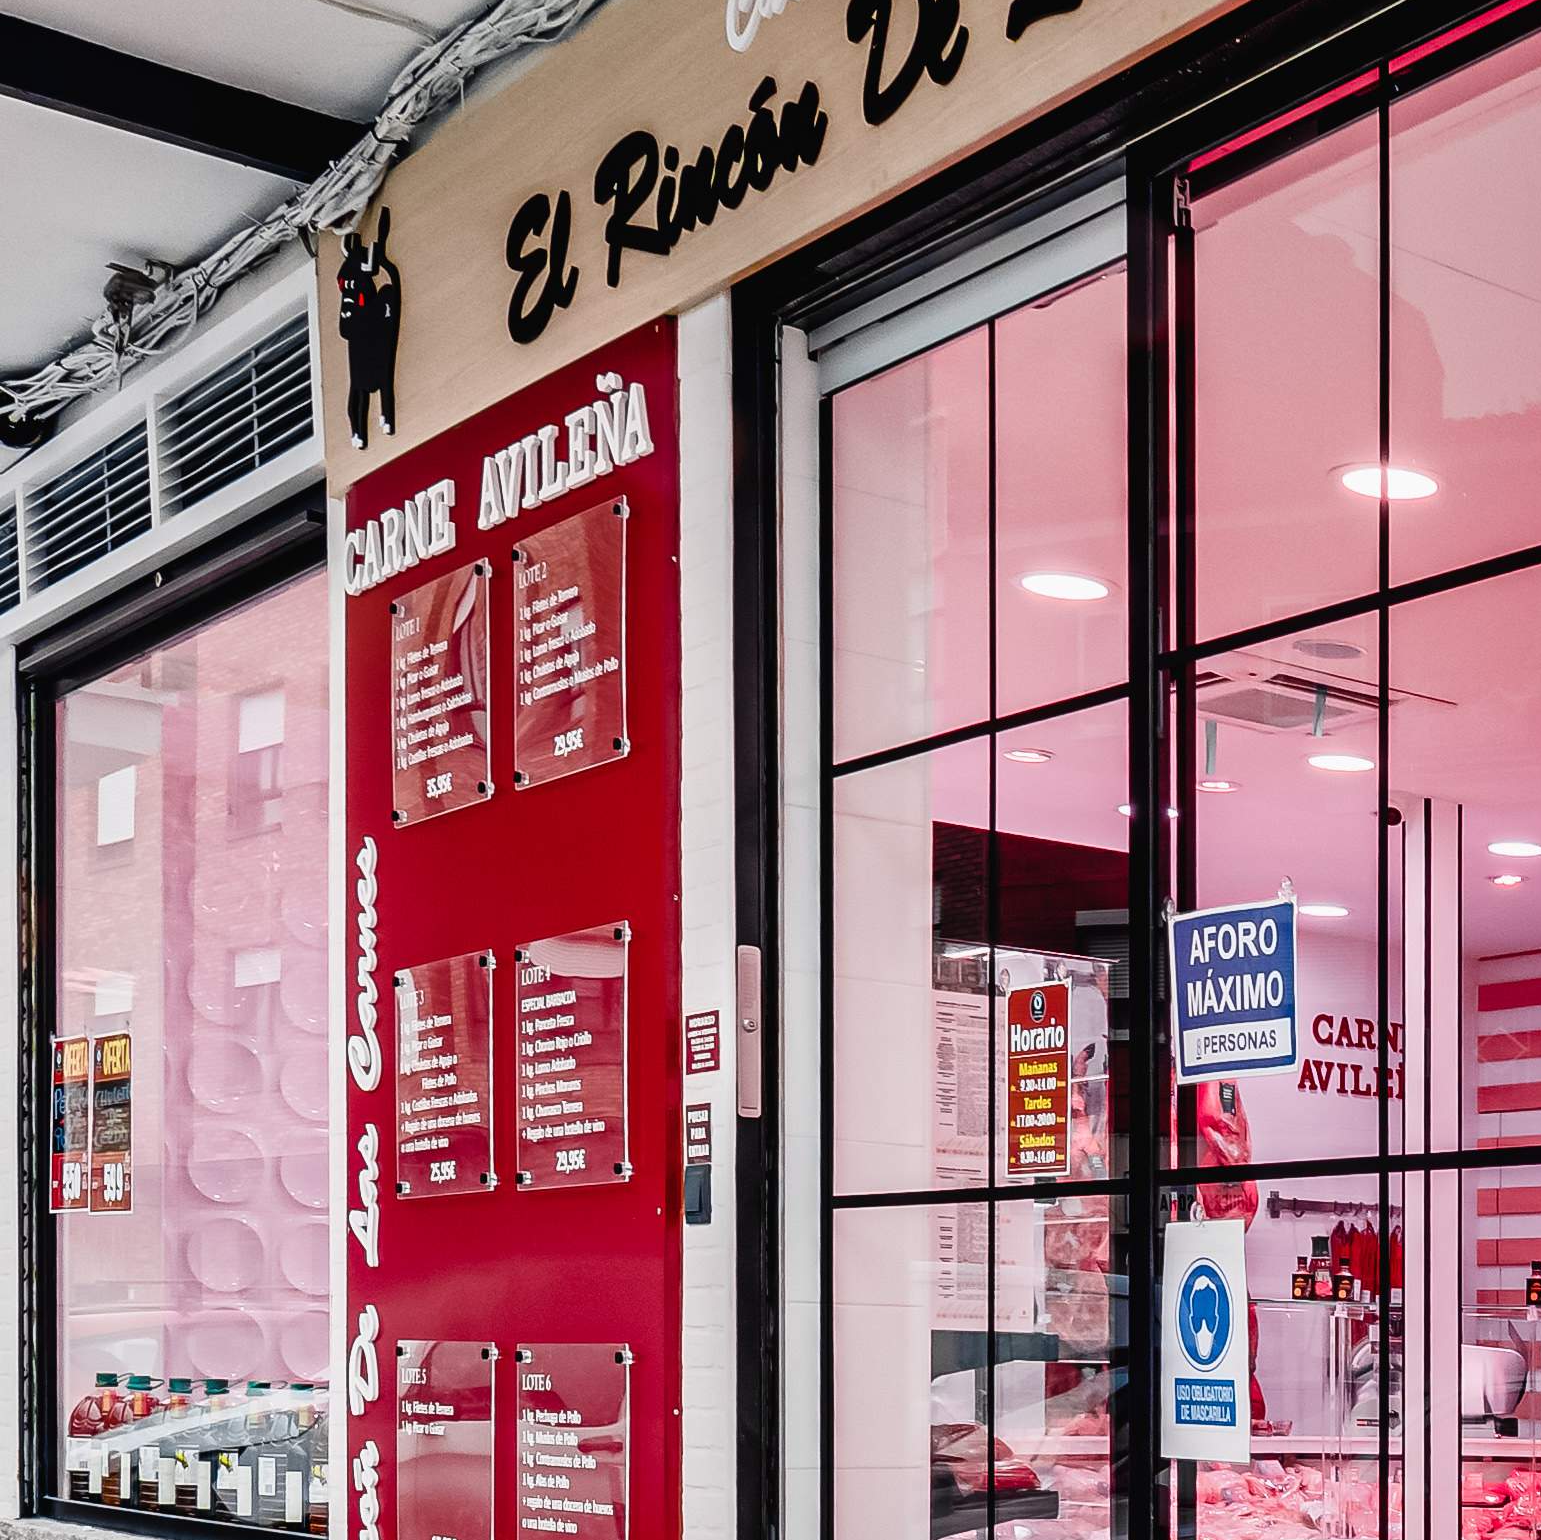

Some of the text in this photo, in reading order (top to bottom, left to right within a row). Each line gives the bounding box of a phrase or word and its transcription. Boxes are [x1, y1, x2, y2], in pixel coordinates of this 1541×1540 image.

[505, 191, 577, 345] El
[600, 75, 827, 288] Rincón
[344, 372, 654, 596] CARNE AVILEÑA
[519, 562, 547, 589] LOTE 2
[553, 728, 583, 756] 29,95€
[1189, 918, 1277, 966] AFORO
[348, 836, 382, 1092] Carnes
[521, 963, 551, 986] LOTE 4
[1187, 968, 1284, 1018] MÁXIMO
[1010, 1018, 1065, 1053] Horario
[1204, 1029, 1277, 1055] PERSONAS
[1312, 1014, 1405, 1054] CARN
[63, 1041, 89, 1078] OFERTA
[103, 1038, 130, 1075] OFERTA
[1018, 1061, 1057, 1077] Mañanas
[1023, 1095, 1052, 1110] Tardes
[1019, 1132, 1055, 1148] Sábados
[430, 1161, 456, 1184] 25,95€
[555, 1148, 586, 1174] 29,95€
[349, 1123, 380, 1268] Las
[349, 1304, 380, 1416] De
[401, 1367, 427, 1384] LOTE 5
[522, 1374, 552, 1391] LOTE 6
[1177, 1385, 1233, 1403] USO OBLIGATORIO
[1180, 1404, 1232, 1422] DE MASCARILLA
